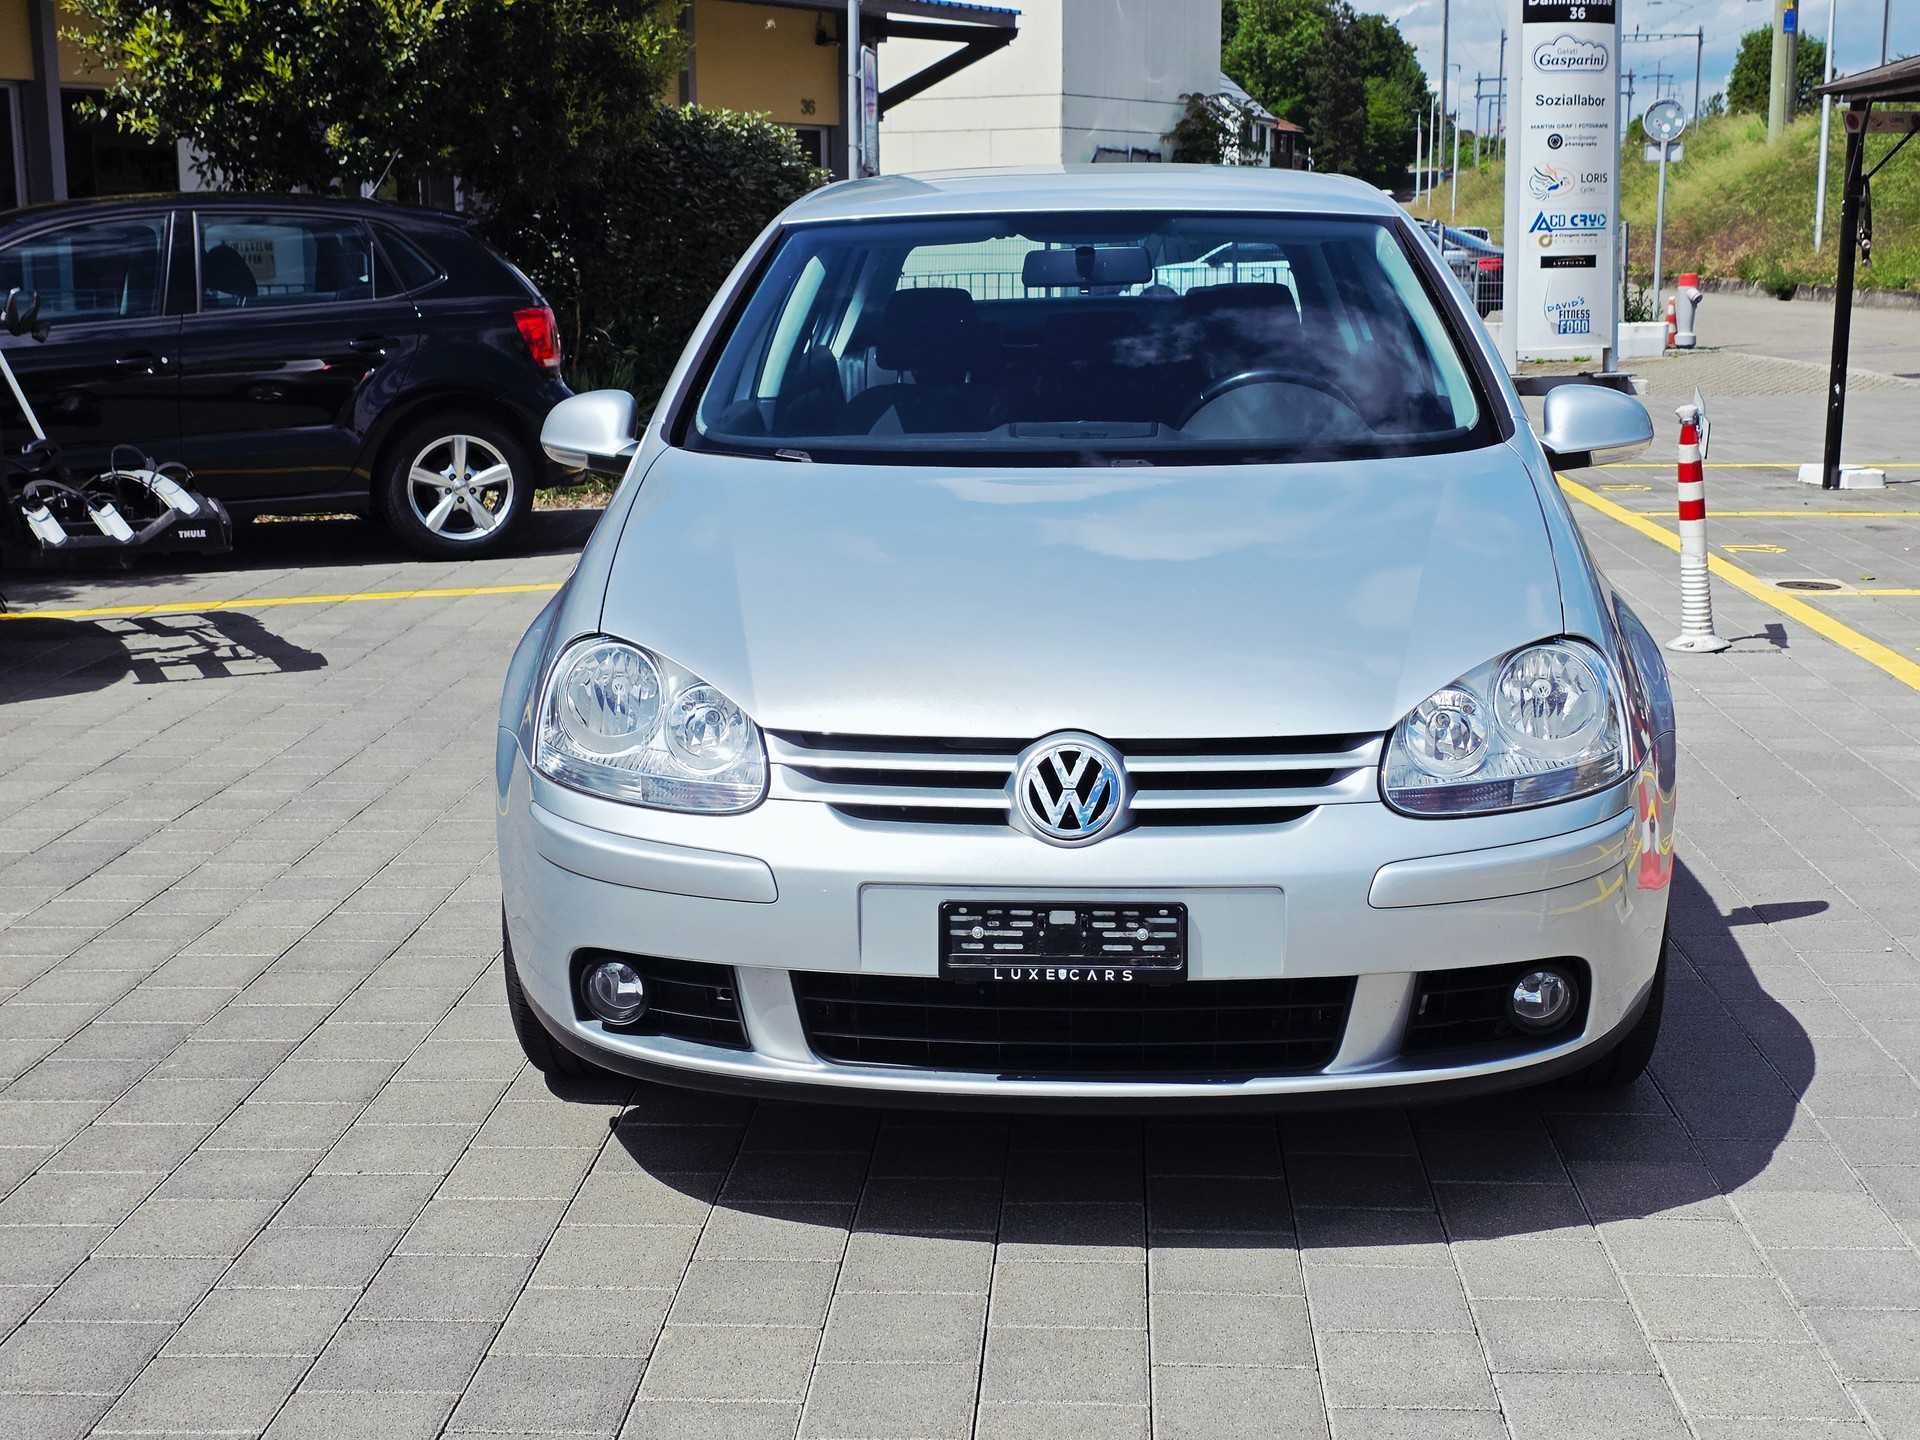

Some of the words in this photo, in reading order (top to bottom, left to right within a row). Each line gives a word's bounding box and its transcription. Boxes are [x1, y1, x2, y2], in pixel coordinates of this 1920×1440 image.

[1569, 7, 1586, 20] 36
[1557, 47, 1578, 55] Gelati
[1539, 53, 1605, 68] Gasparini
[1535, 93, 1606, 107] Soziallabor
[800, 99, 816, 116] 36
[1580, 172, 1608, 184] LORIS
[1547, 295, 1585, 312] DAVID'S
[1559, 309, 1591, 319] FITNESS
[1559, 319, 1590, 334] FOOD
[178, 530, 206, 539] THULE
[1021, 743, 1119, 837] VW
[994, 968, 1056, 981] LUXE
[1069, 969, 1134, 982] CARS
